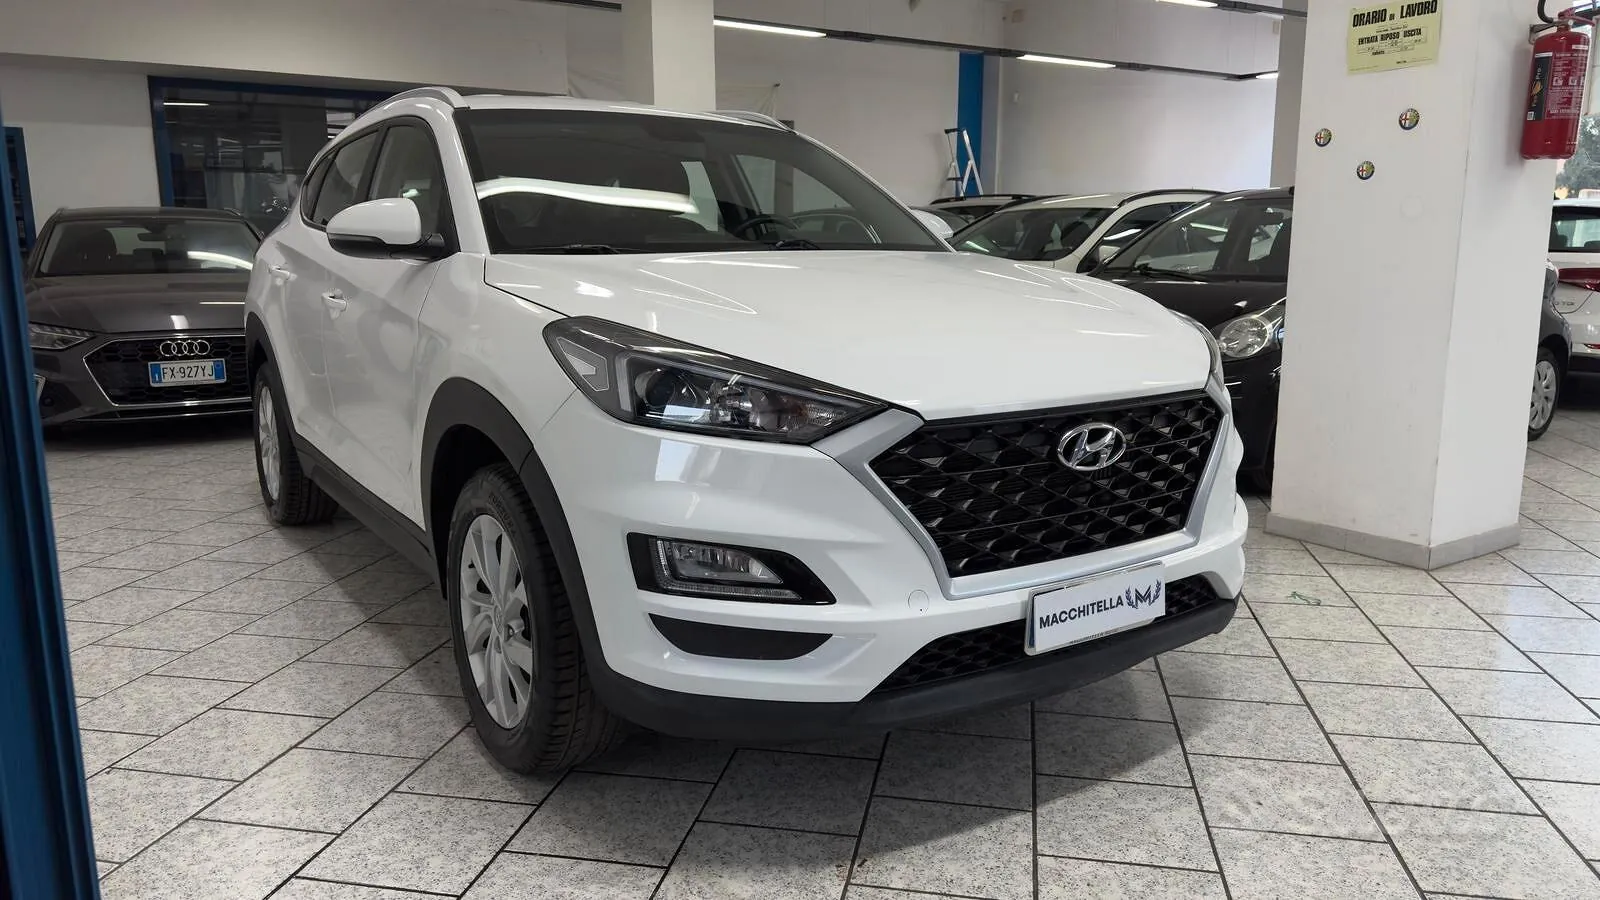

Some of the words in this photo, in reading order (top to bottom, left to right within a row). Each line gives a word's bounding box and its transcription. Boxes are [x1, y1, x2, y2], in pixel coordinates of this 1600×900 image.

[1352, 8, 1387, 28] ORARIO
[1400, 0, 1438, 19] LAVORO
[1358, 35, 1378, 45] ENTRATA
[1380, 31, 1400, 41] RIPOSO
[1403, 28, 1422, 38] USCITA
[1039, 595, 1124, 629] MACCHITELLA
